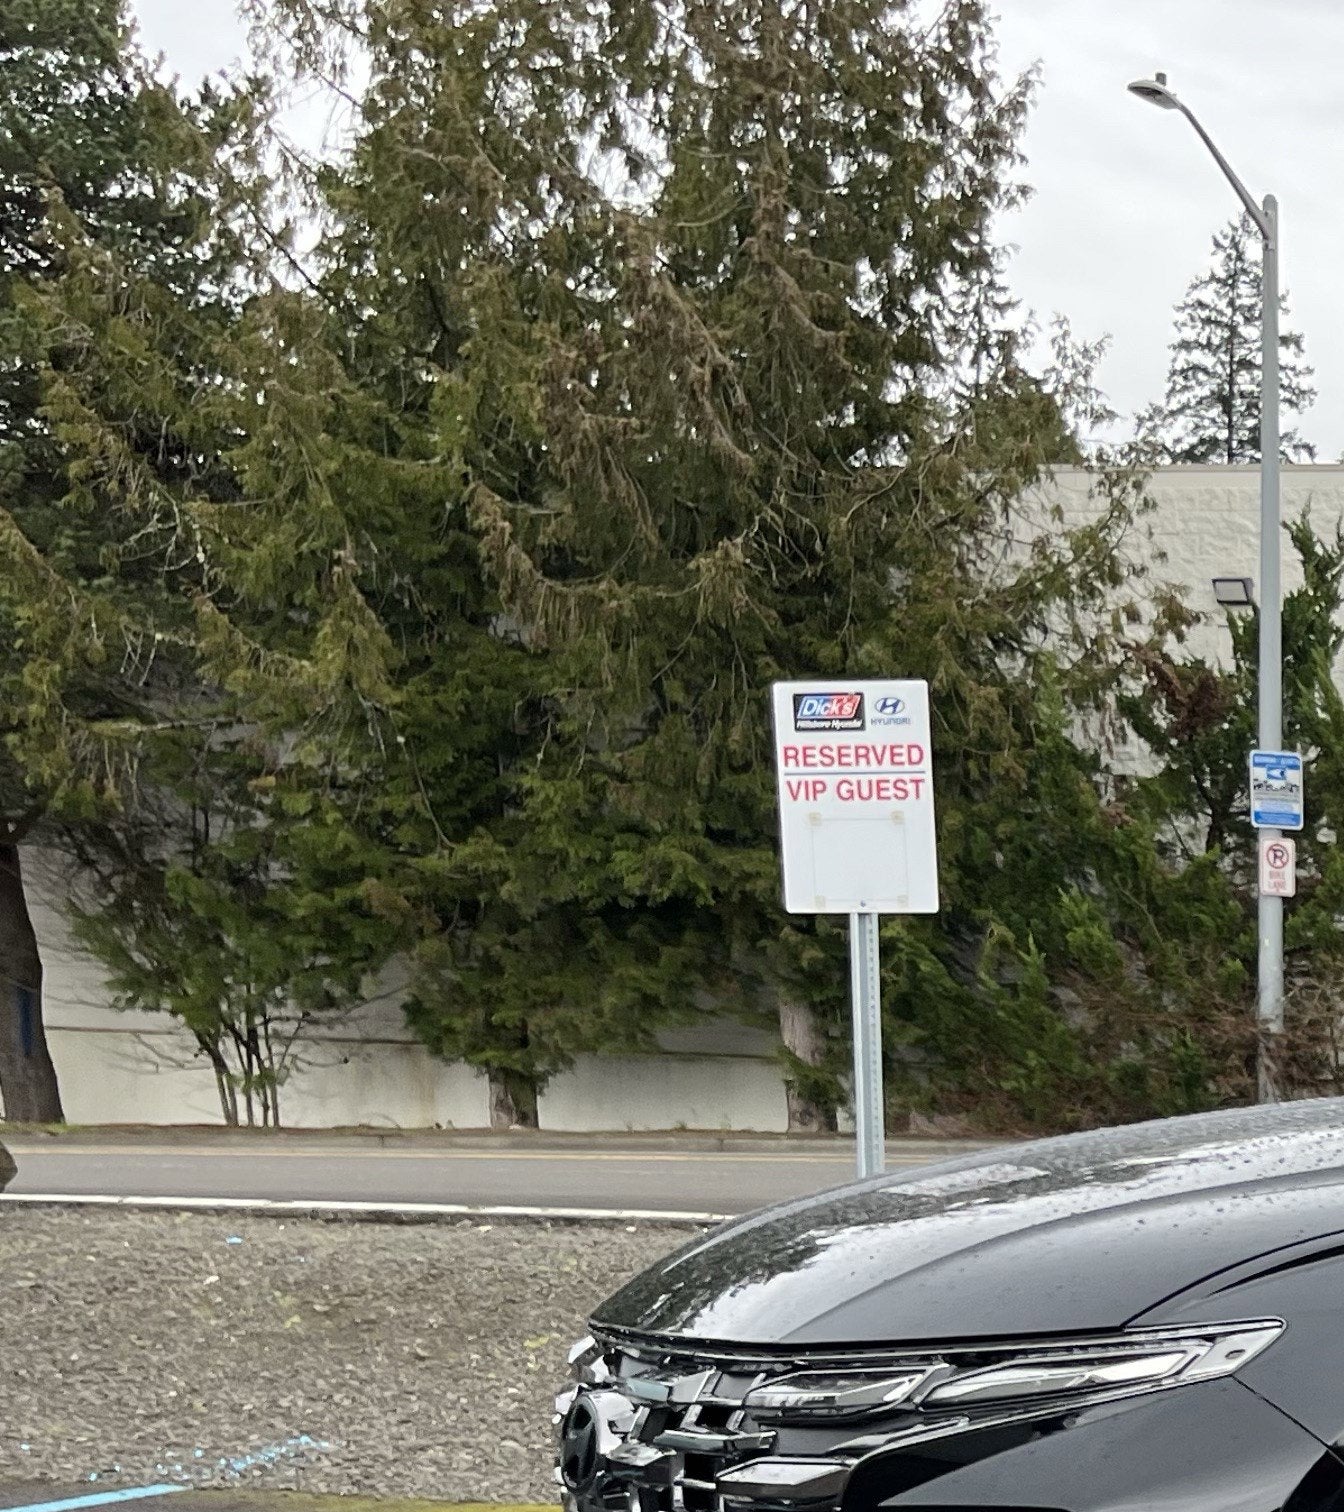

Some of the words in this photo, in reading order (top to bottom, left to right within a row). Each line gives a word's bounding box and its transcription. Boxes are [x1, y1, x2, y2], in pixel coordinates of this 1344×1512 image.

[783, 743, 924, 767] RESERVED
[787, 779, 827, 801] VIP
[836, 778, 925, 801] GUEST
